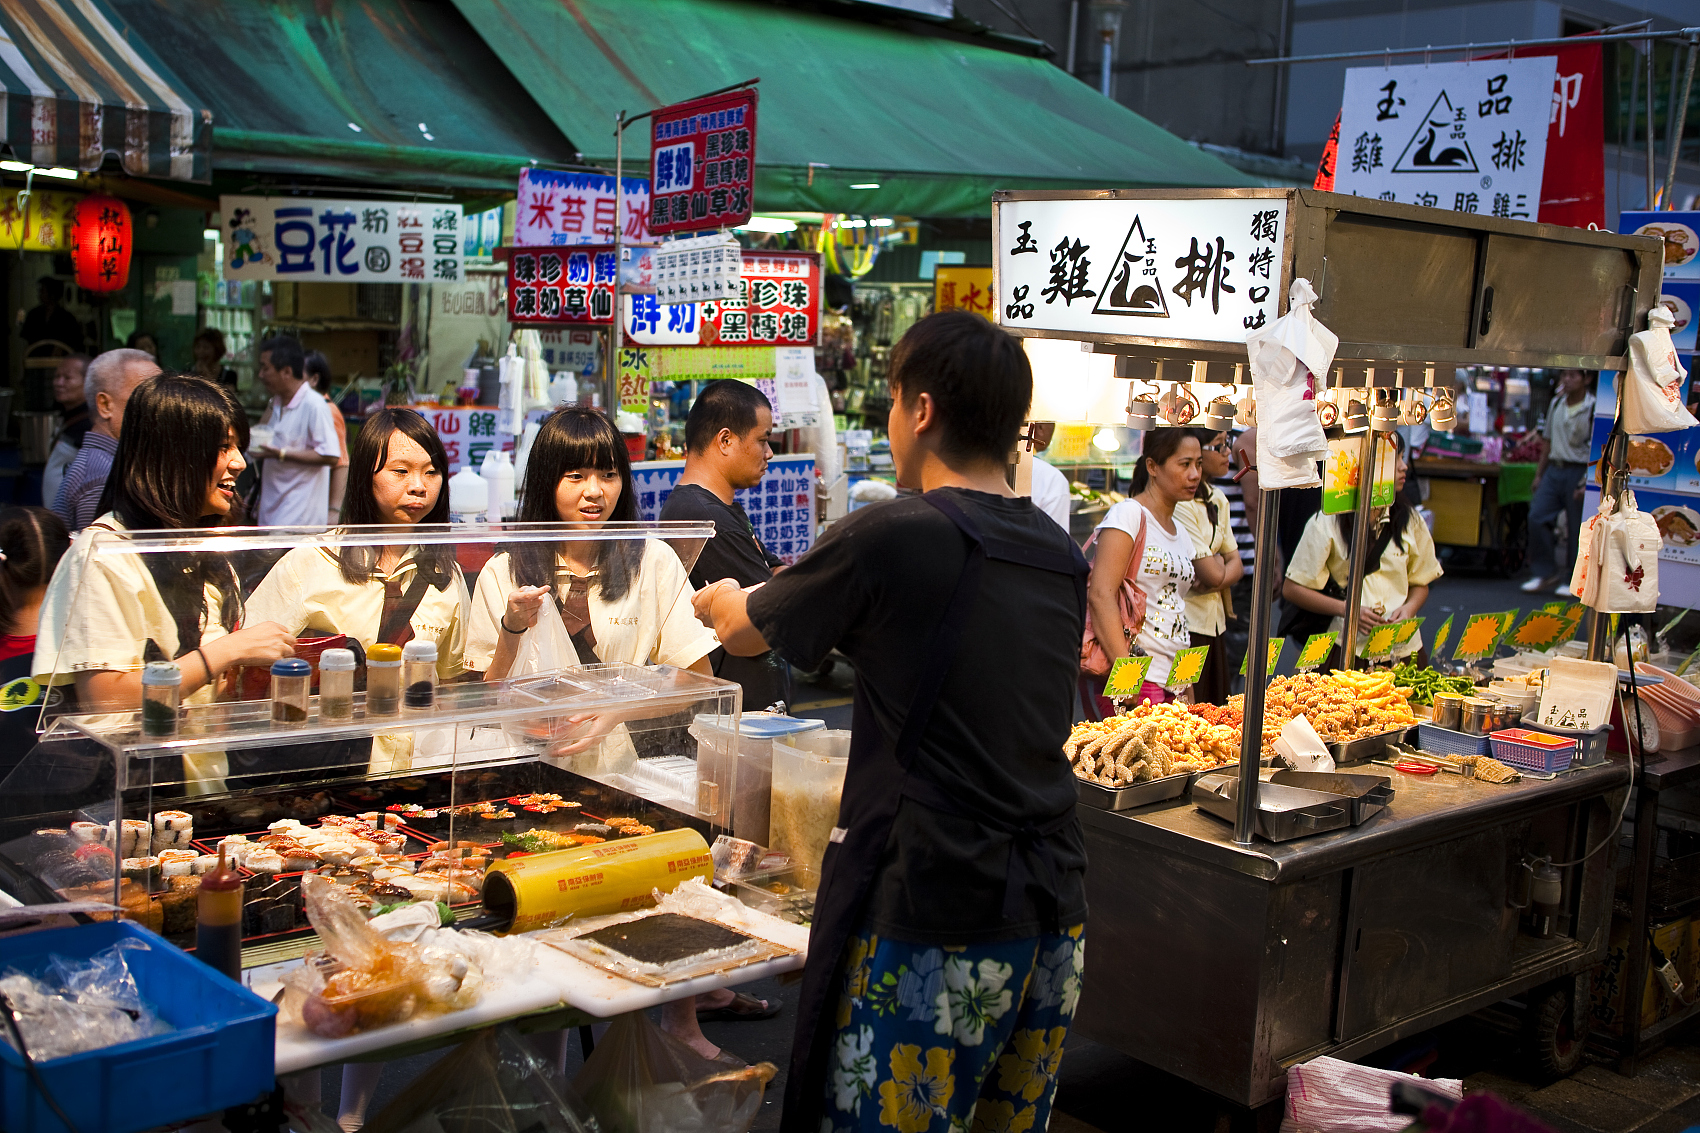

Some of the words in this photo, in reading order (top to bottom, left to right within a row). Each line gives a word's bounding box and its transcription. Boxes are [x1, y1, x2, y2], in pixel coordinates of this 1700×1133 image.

[1376, 80, 1406, 121] 玉
[1478, 74, 1513, 118] 品
[706, 128, 749, 159] 黑珍珠
[1351, 131, 1384, 175] 雞
[1491, 130, 1526, 172] 排
[656, 146, 692, 191] 鮮奶
[652, 186, 749, 226] 黑糖仙草冰
[274, 206, 359, 275] 豆花
[362, 208, 390, 273] 粉圓
[396, 207, 425, 280] 紅豆湯
[432, 208, 458, 281] 綠豆湯
[1141, 238, 1158, 276] 玉品
[1040, 235, 1097, 307] 雞
[1172, 236, 1236, 315] 排
[1243, 209, 1280, 330] 獨特口味
[630, 293, 696, 335] 鮮奶
[721, 312, 807, 341] 黑磚塊
[620, 373, 649, 406] 熱
[795, 477, 810, 553] 冷熱巧克力
